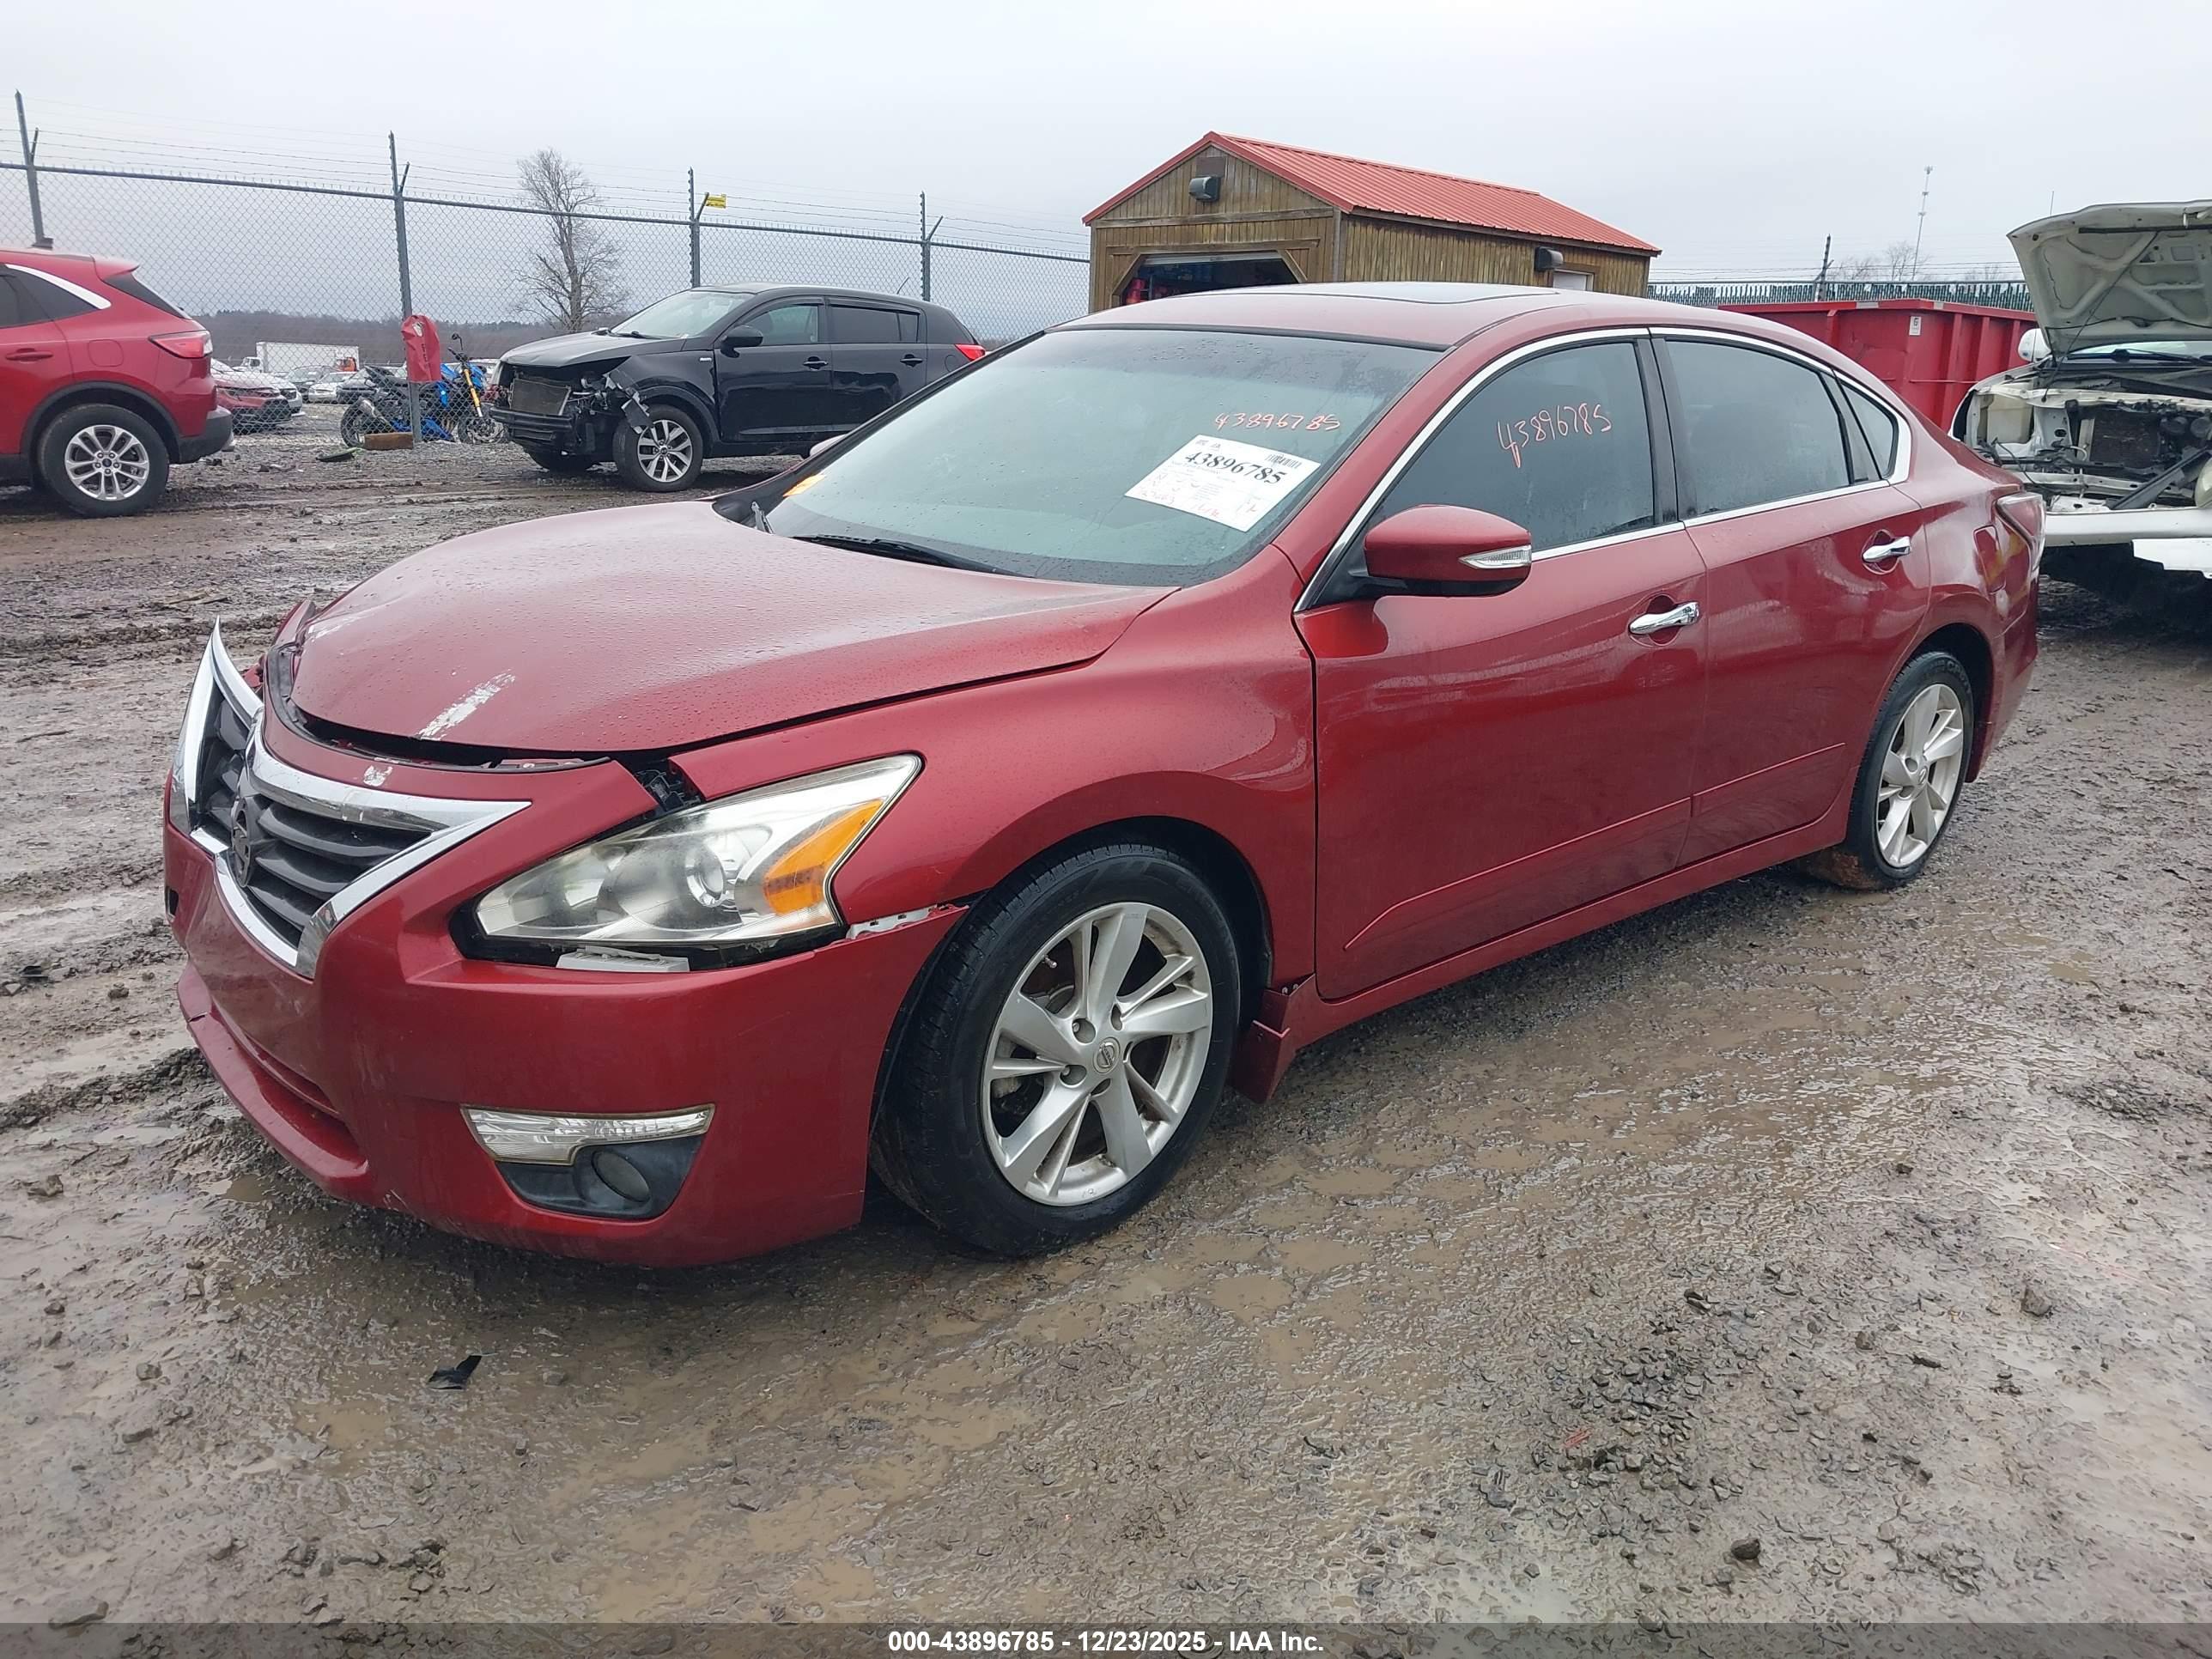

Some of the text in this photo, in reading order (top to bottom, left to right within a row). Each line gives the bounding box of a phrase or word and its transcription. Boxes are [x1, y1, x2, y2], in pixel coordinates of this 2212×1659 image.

[1215, 412, 1340, 431] 43896785
[1498, 403, 1612, 468] 43896785
[1185, 451, 1287, 484] 43896785
